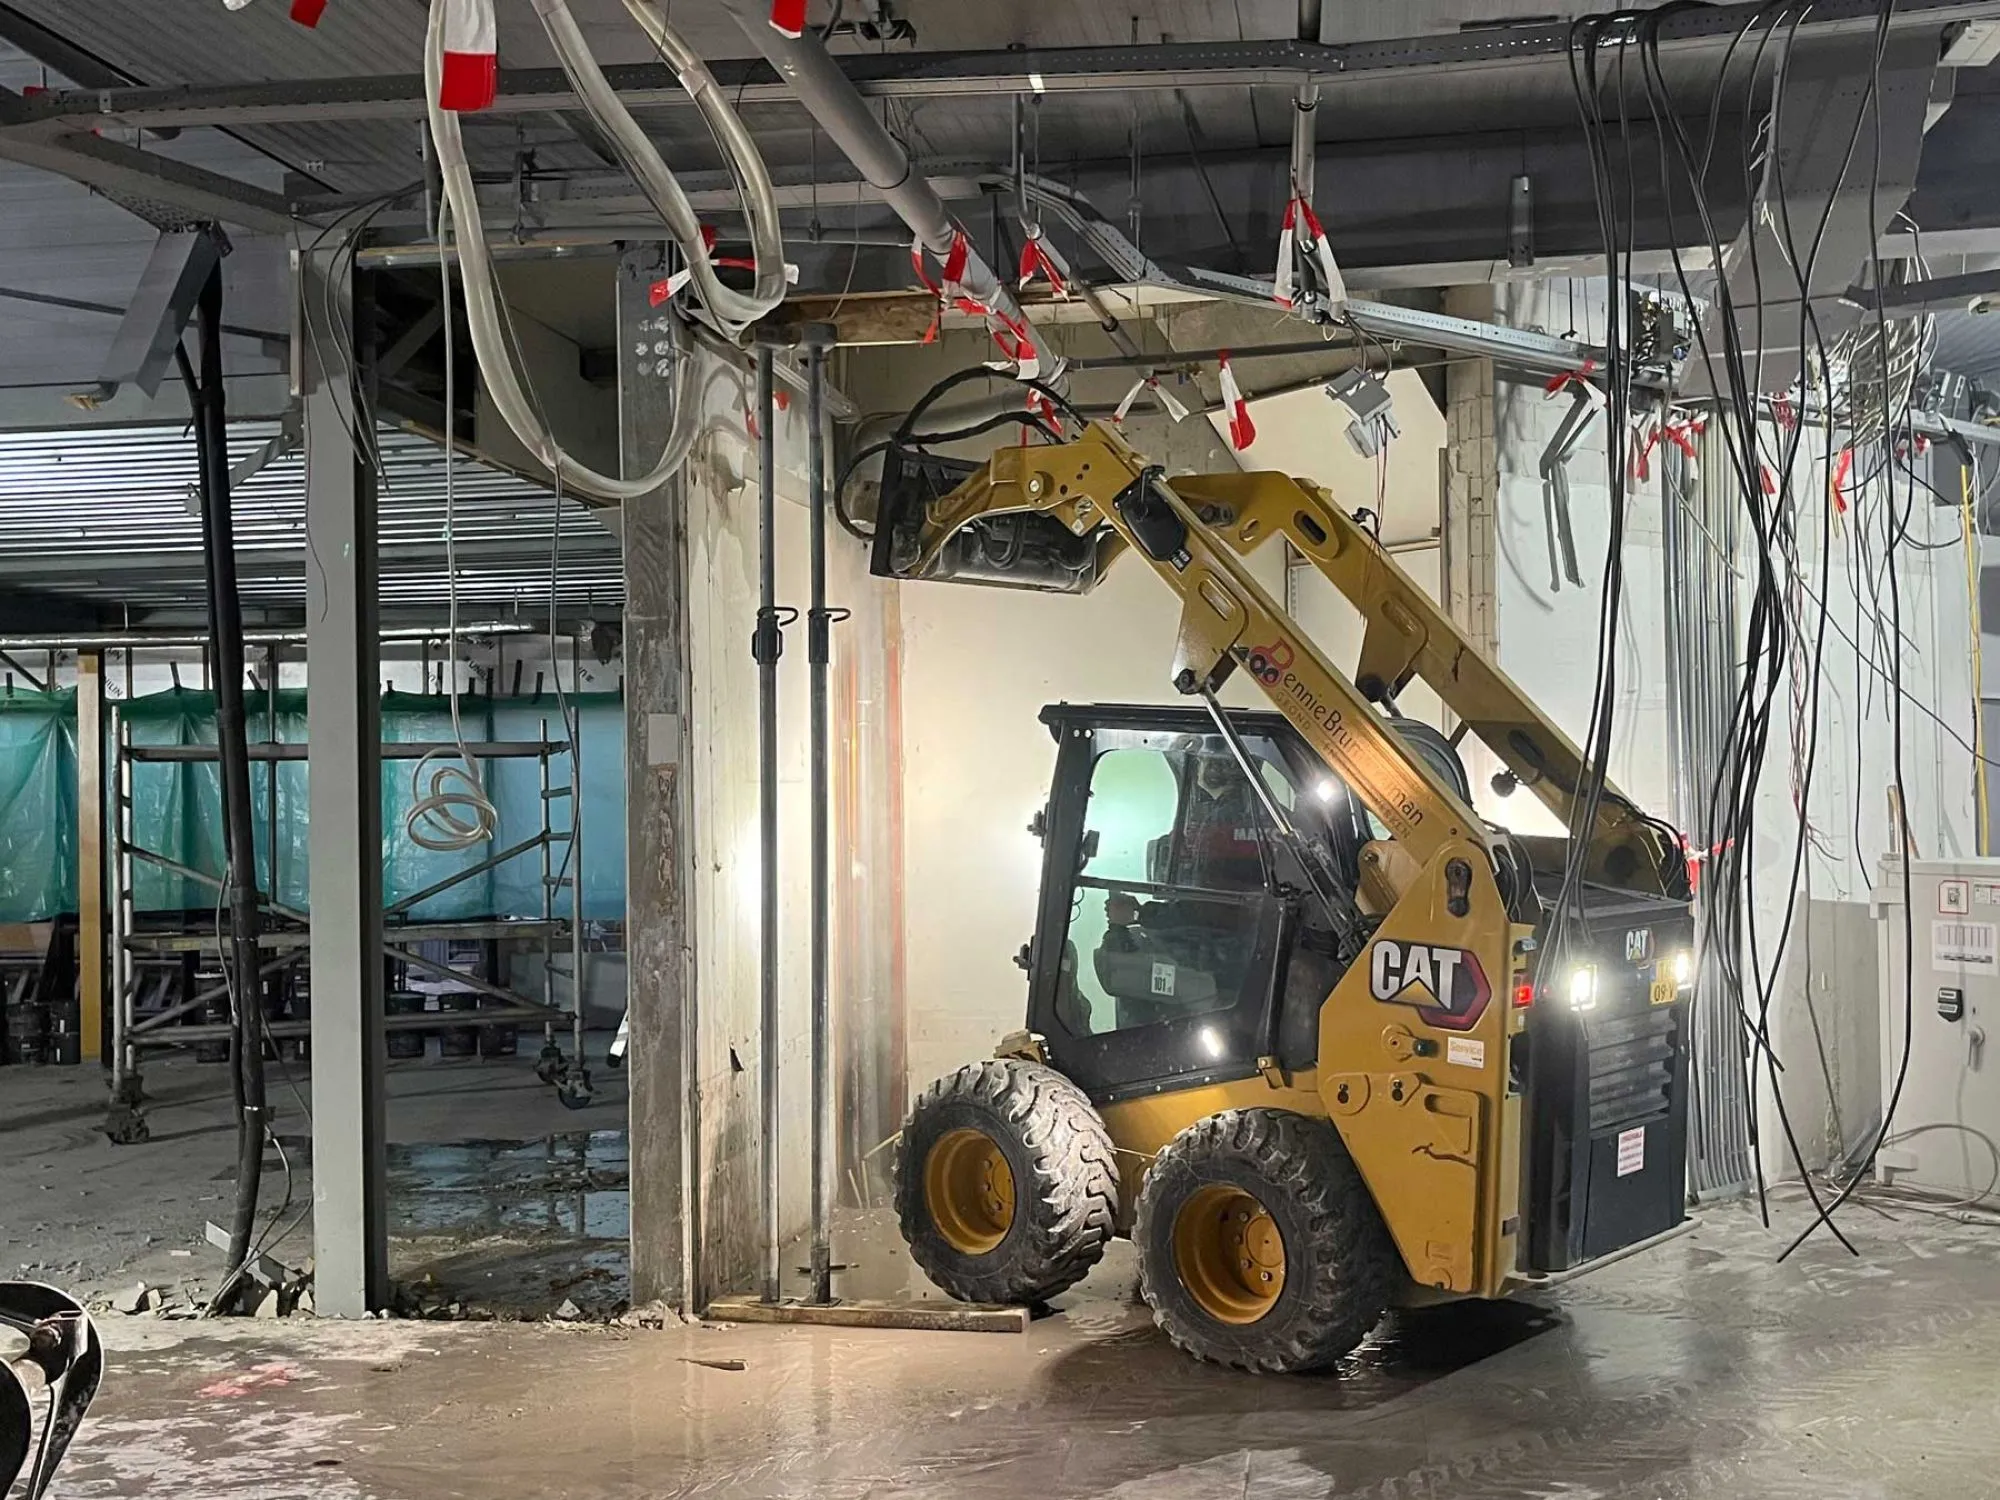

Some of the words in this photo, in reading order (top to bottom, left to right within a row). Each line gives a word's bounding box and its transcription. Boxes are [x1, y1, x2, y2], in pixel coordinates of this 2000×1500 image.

[1626, 929, 1648, 961] CAT
[1154, 976, 1166, 992] 101
[1372, 940, 1462, 1010] CAT
